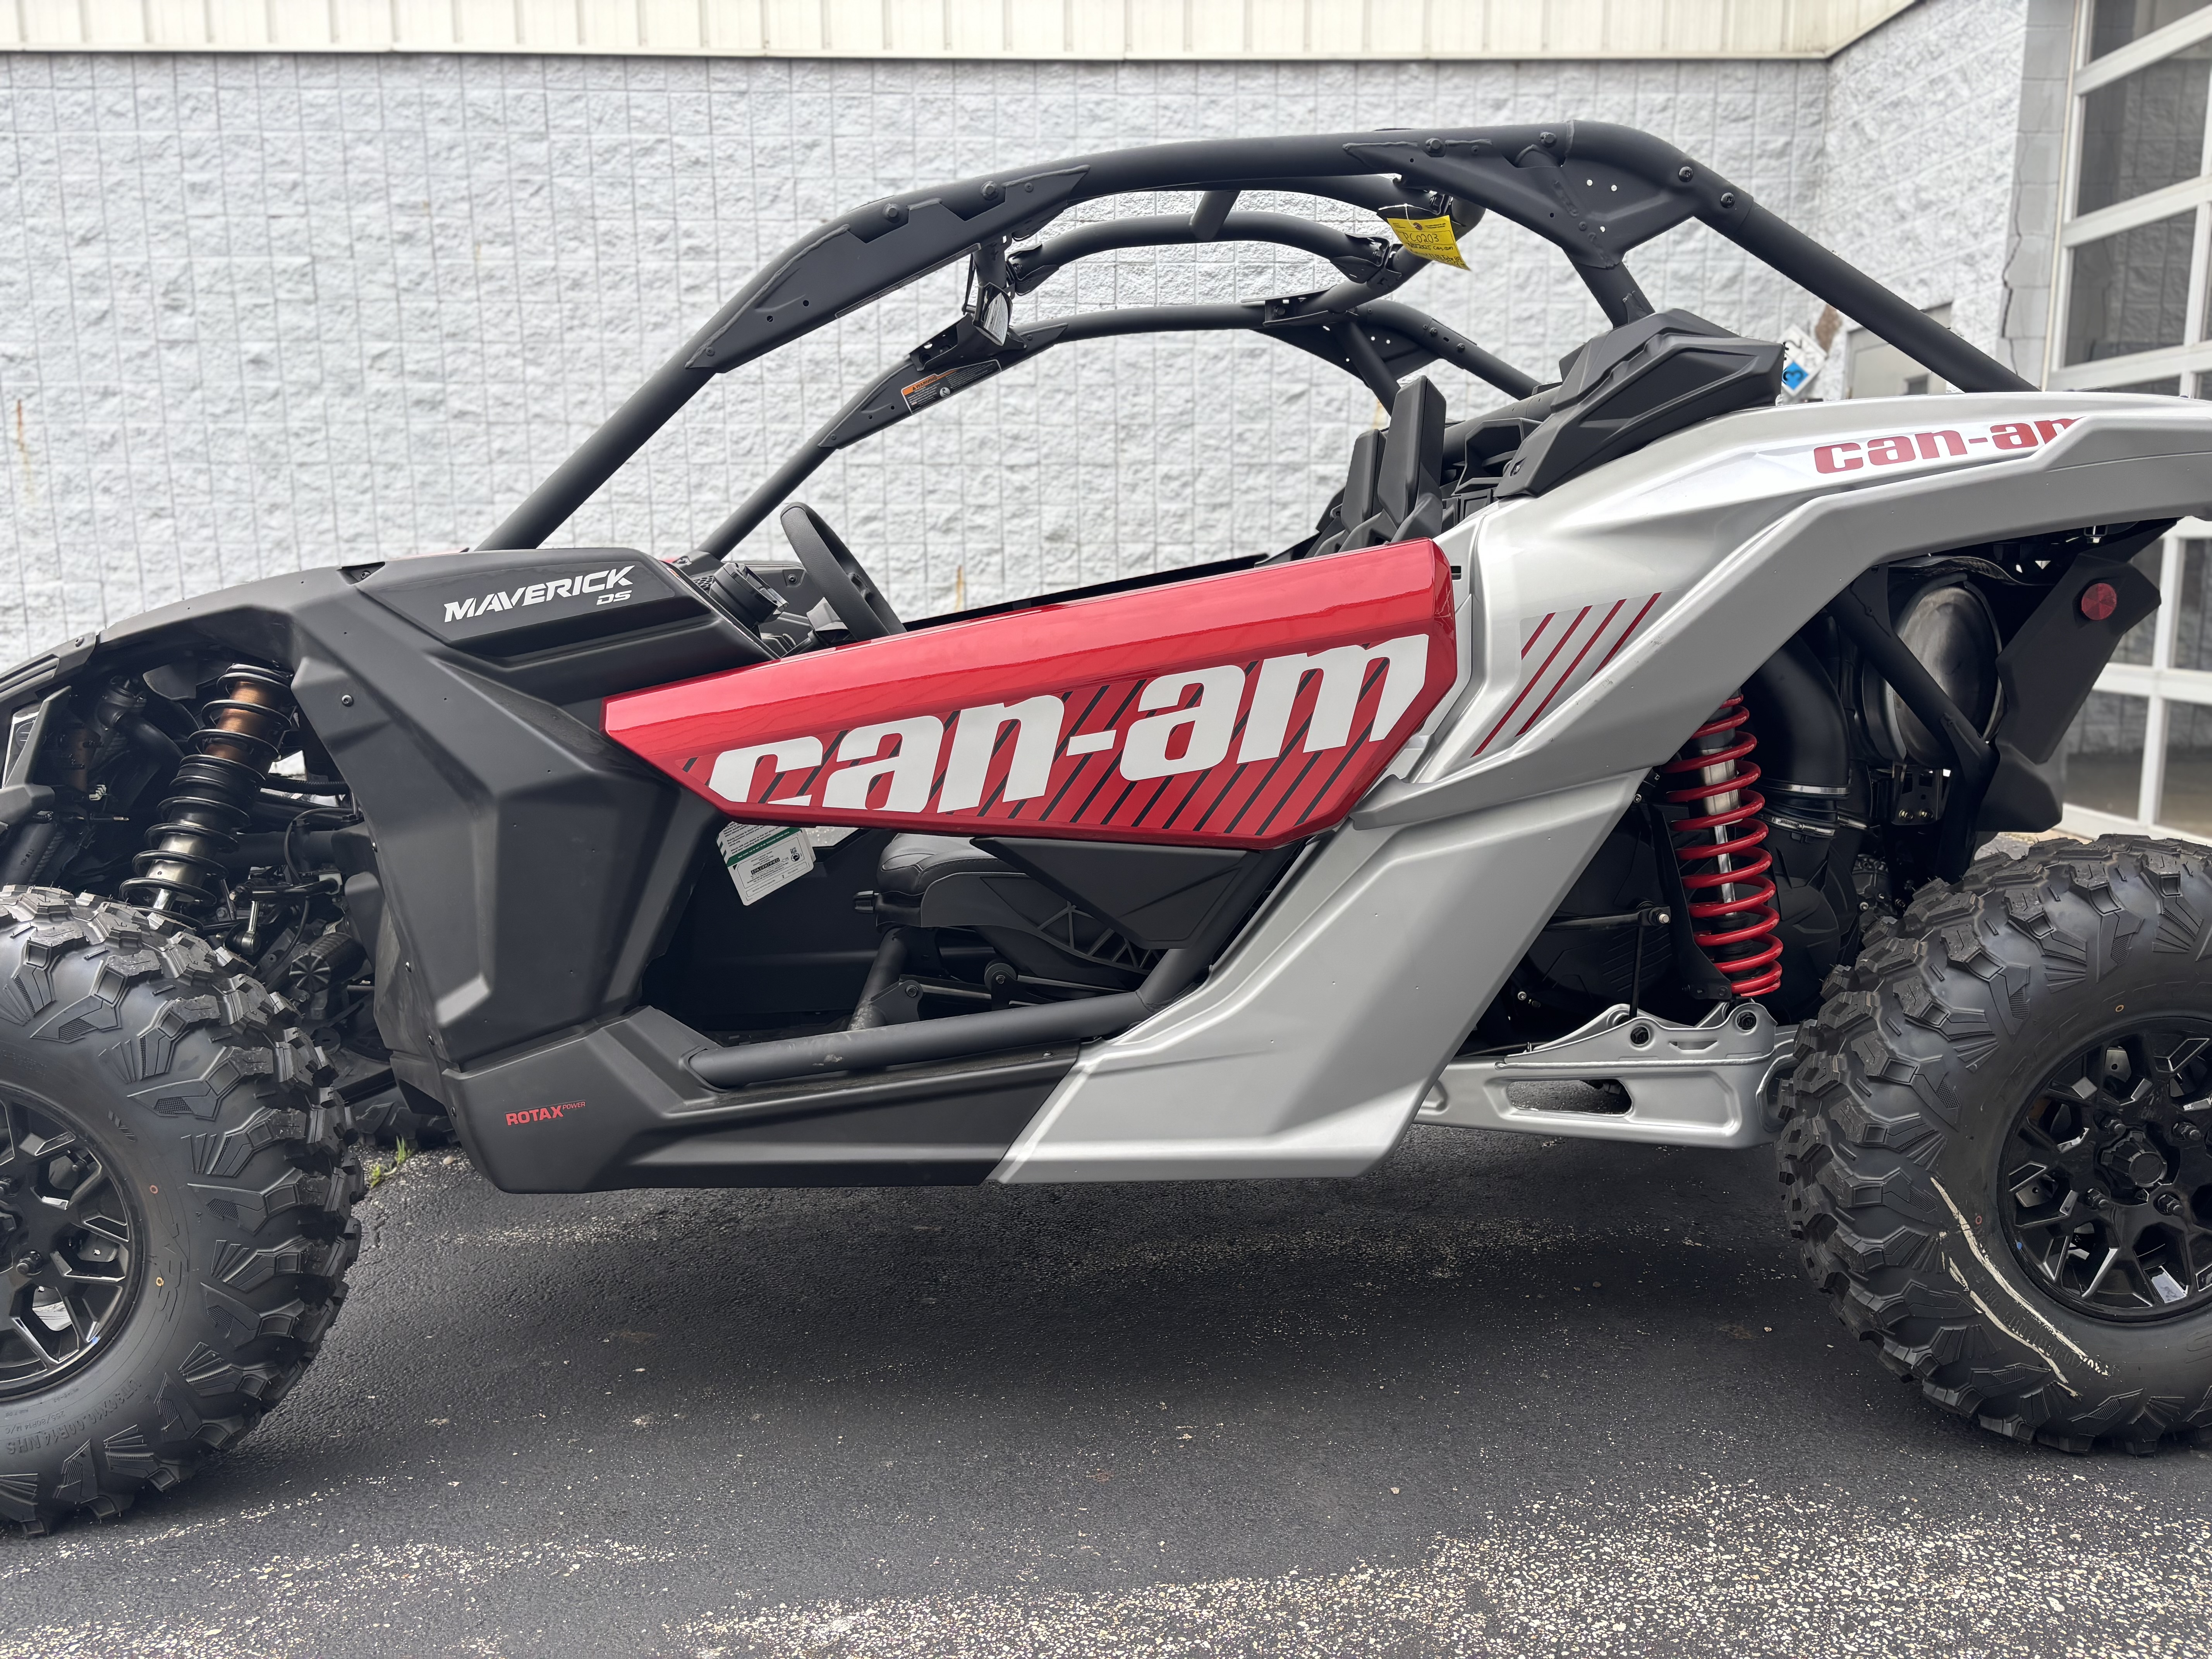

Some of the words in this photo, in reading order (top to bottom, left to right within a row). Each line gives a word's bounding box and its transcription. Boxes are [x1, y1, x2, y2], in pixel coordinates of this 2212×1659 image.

[1403, 232, 1439, 243] PC0203
[915, 376, 938, 388] WARNING
[1783, 370, 1804, 381] 3
[444, 565, 635, 622] MAVERICK
[596, 590, 632, 605] DS
[707, 634, 1429, 813] can-am
[506, 1105, 564, 1126] ROTAX
[562, 1101, 586, 1110] POWER
